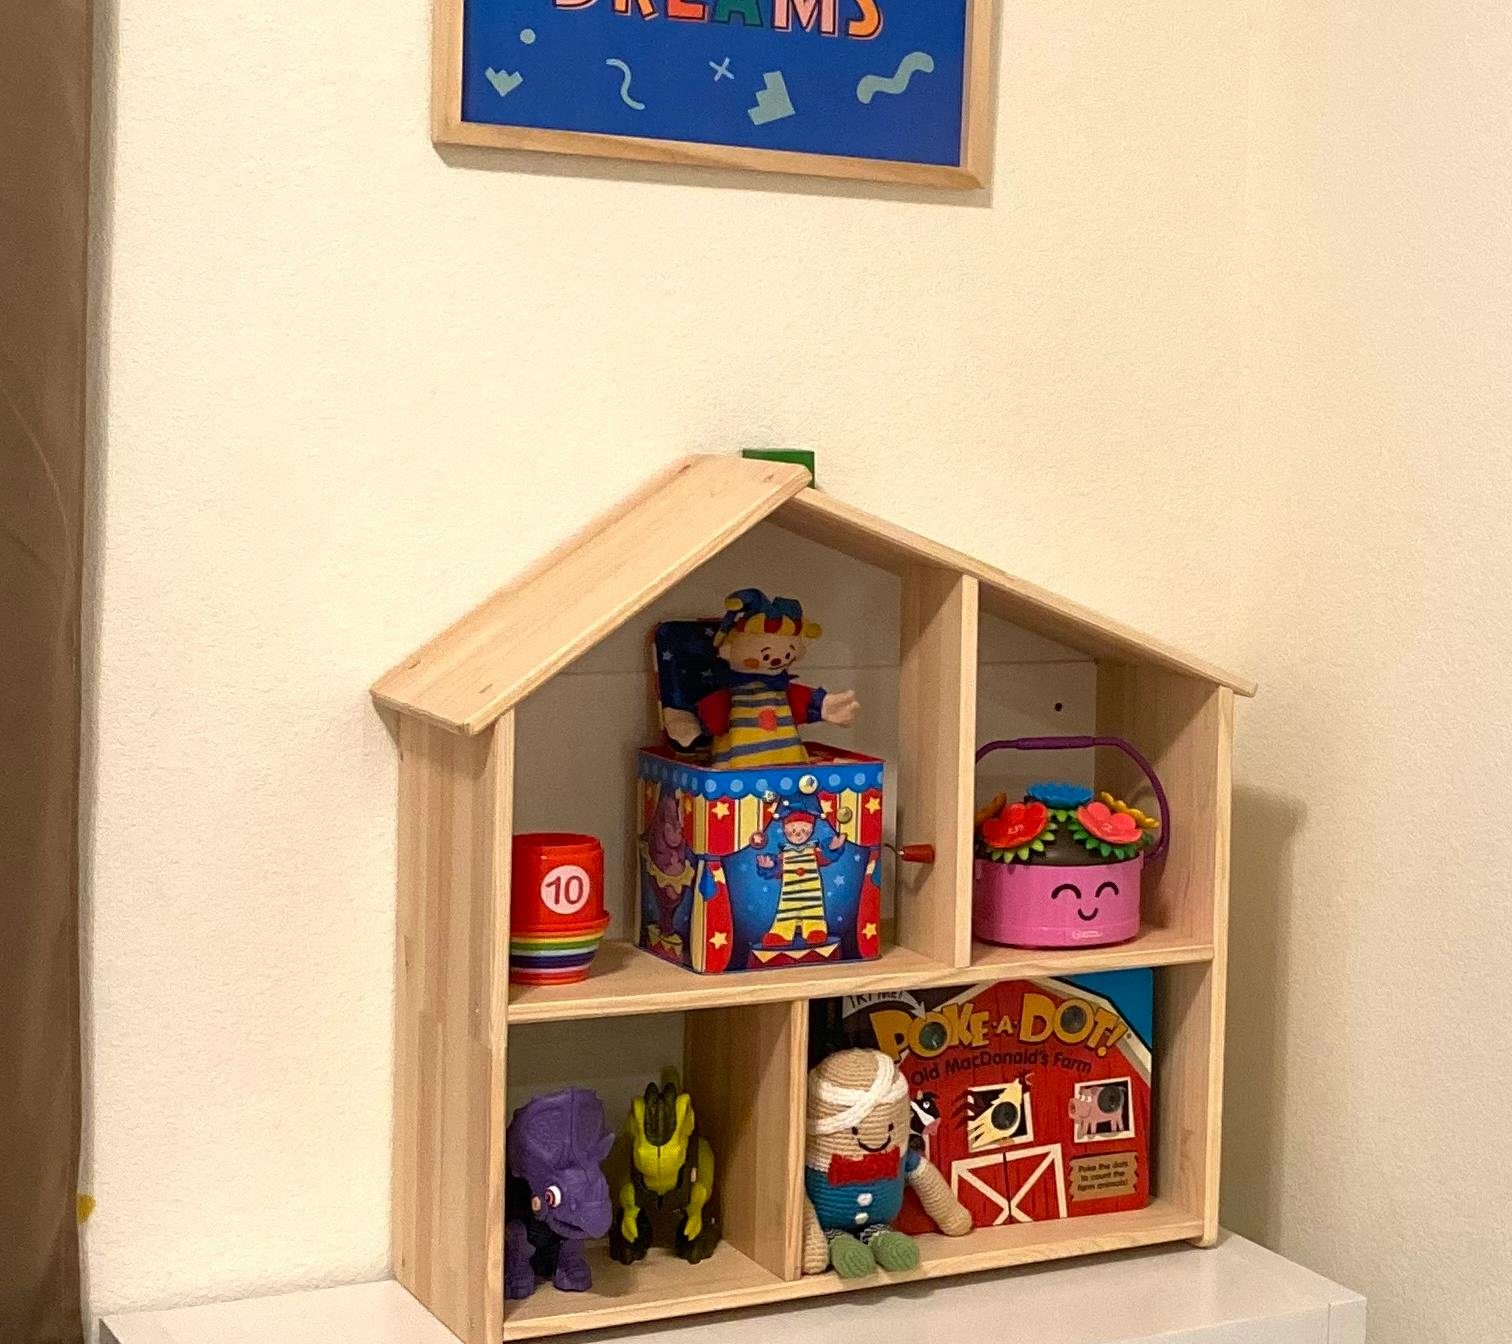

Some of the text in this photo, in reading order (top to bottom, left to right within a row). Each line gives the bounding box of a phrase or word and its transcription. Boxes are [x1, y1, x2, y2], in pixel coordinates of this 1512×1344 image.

[545, 875, 584, 906] 10
[910, 1048, 1093, 1087] Old MacDonald's Farm
